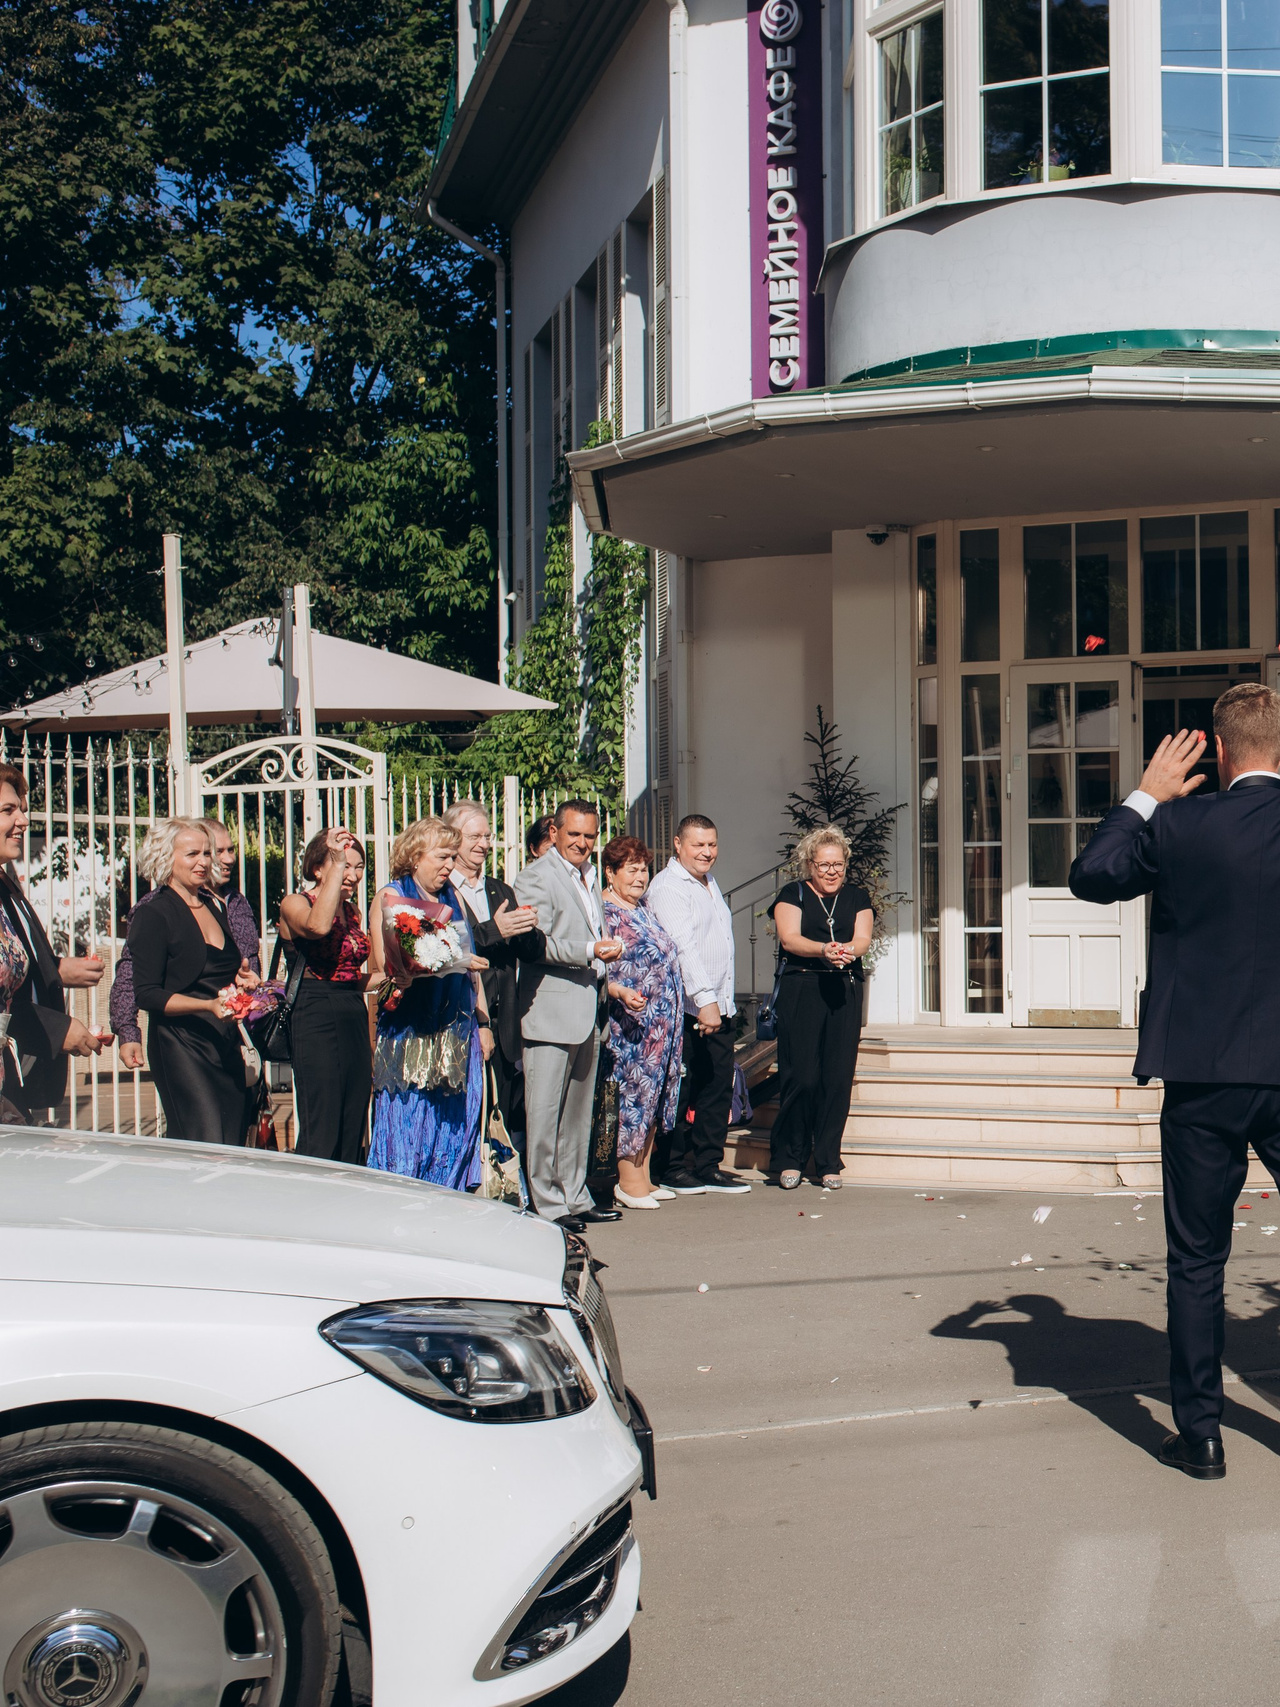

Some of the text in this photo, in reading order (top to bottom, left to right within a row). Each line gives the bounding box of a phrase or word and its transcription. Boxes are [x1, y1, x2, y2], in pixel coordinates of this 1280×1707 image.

[764, 46, 800, 387] СЕМЕЙНОЕ КАФЕ
[58, 899, 82, 908] ROA
[66, 1696, 91, 1706] BENZ
